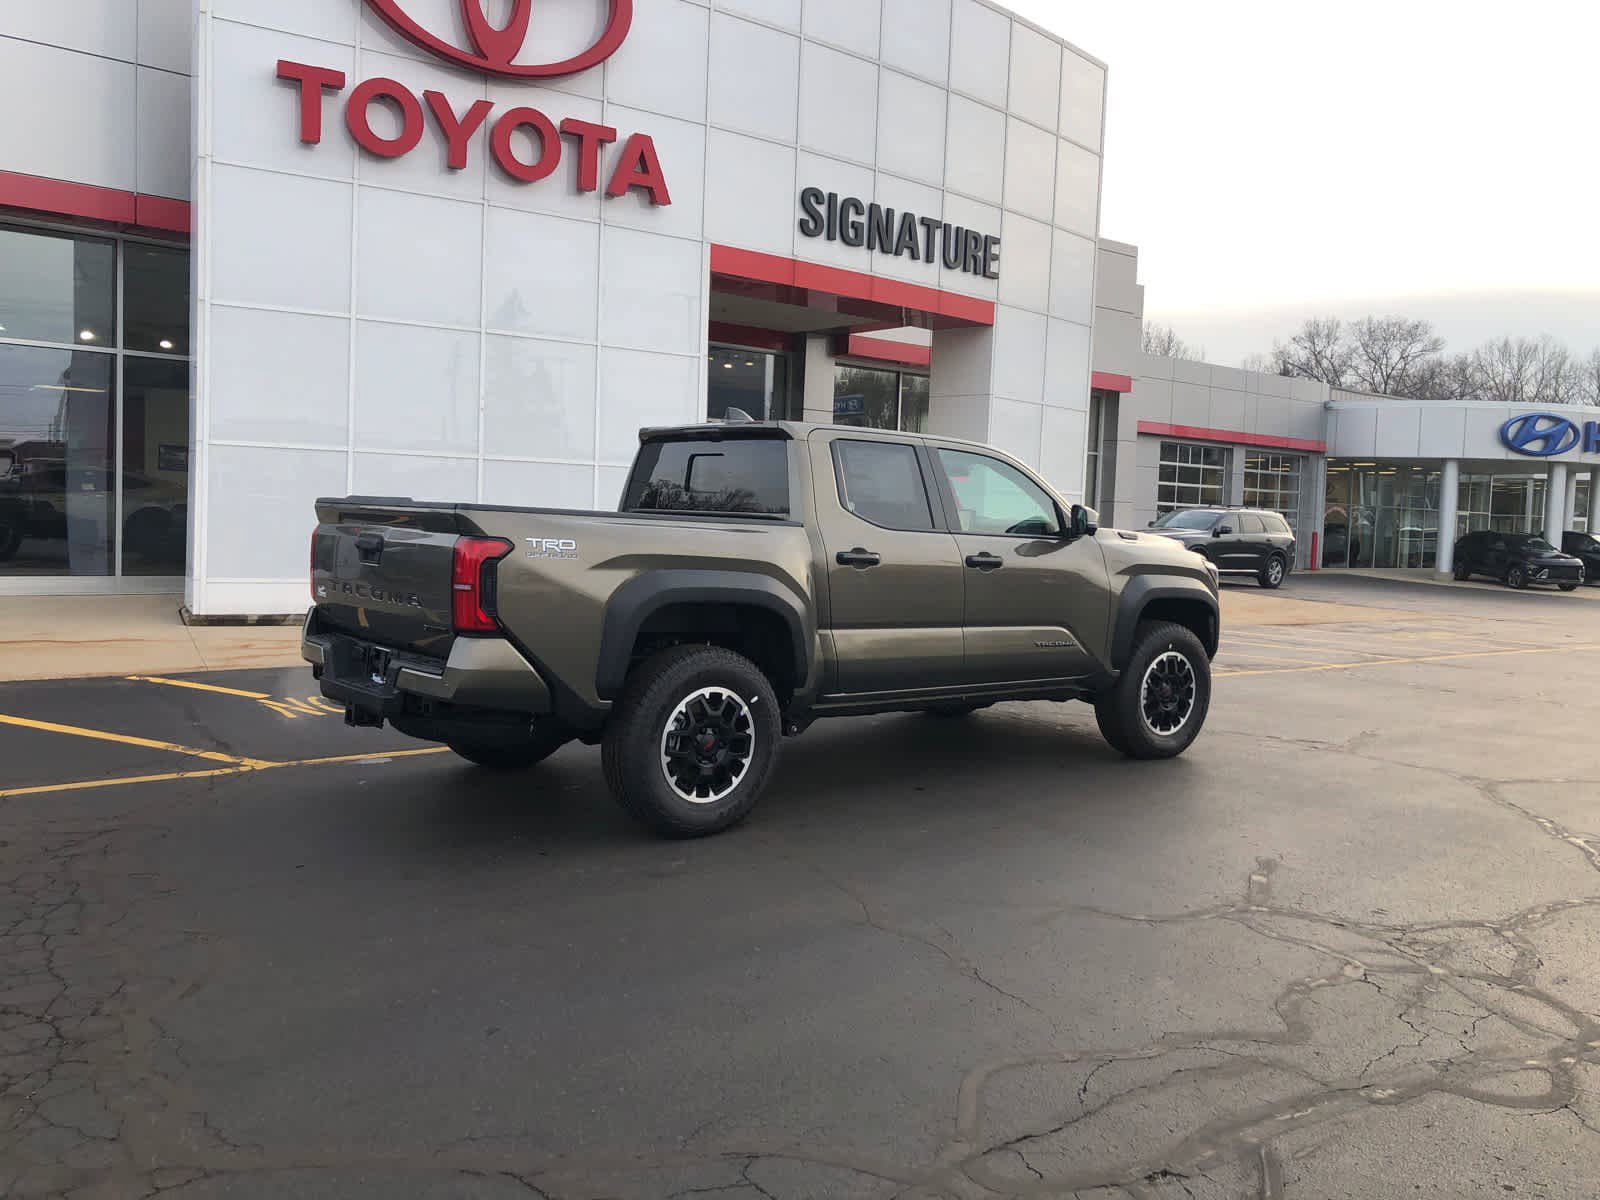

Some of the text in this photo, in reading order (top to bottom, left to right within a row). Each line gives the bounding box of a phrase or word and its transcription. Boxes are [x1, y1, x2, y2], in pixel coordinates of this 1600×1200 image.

[277, 60, 672, 206] TOYOTA
[799, 187, 1001, 280] SIGNATURE
[525, 537, 577, 553] TRD
